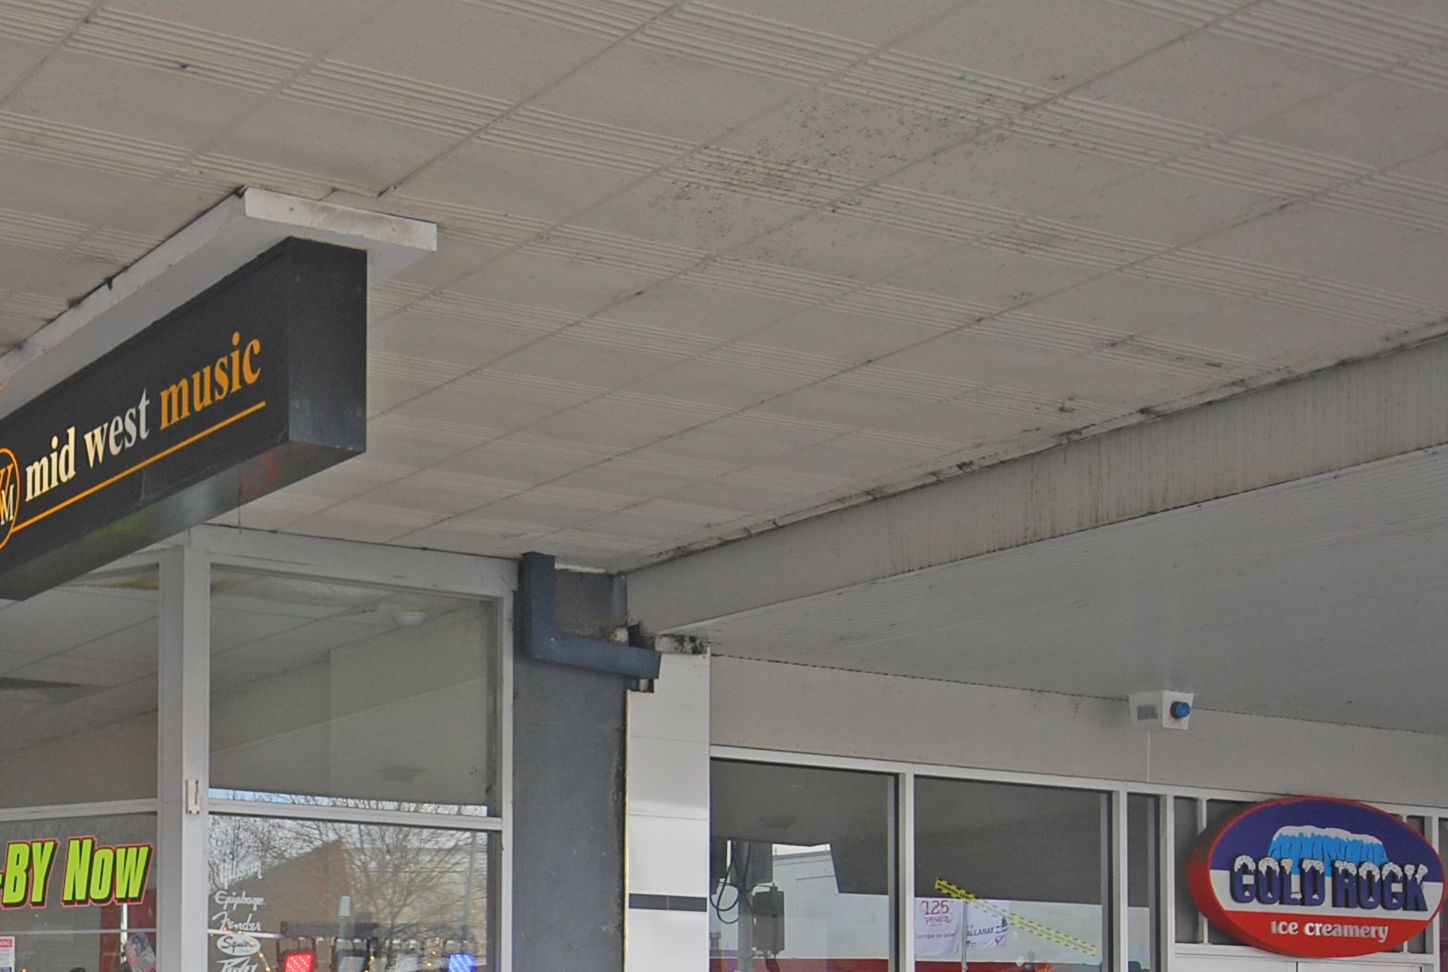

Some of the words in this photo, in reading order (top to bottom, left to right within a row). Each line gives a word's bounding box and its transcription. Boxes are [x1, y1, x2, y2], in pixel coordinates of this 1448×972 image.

[25, 426, 77, 502] mid
[83, 388, 150, 469] west
[159, 331, 262, 430] music
[1230, 854, 1326, 906] COLD
[1332, 858, 1428, 912] ROCK
[920, 900, 950, 915] 125
[212, 911, 261, 932] Fender
[1304, 921, 1389, 943] creamery
